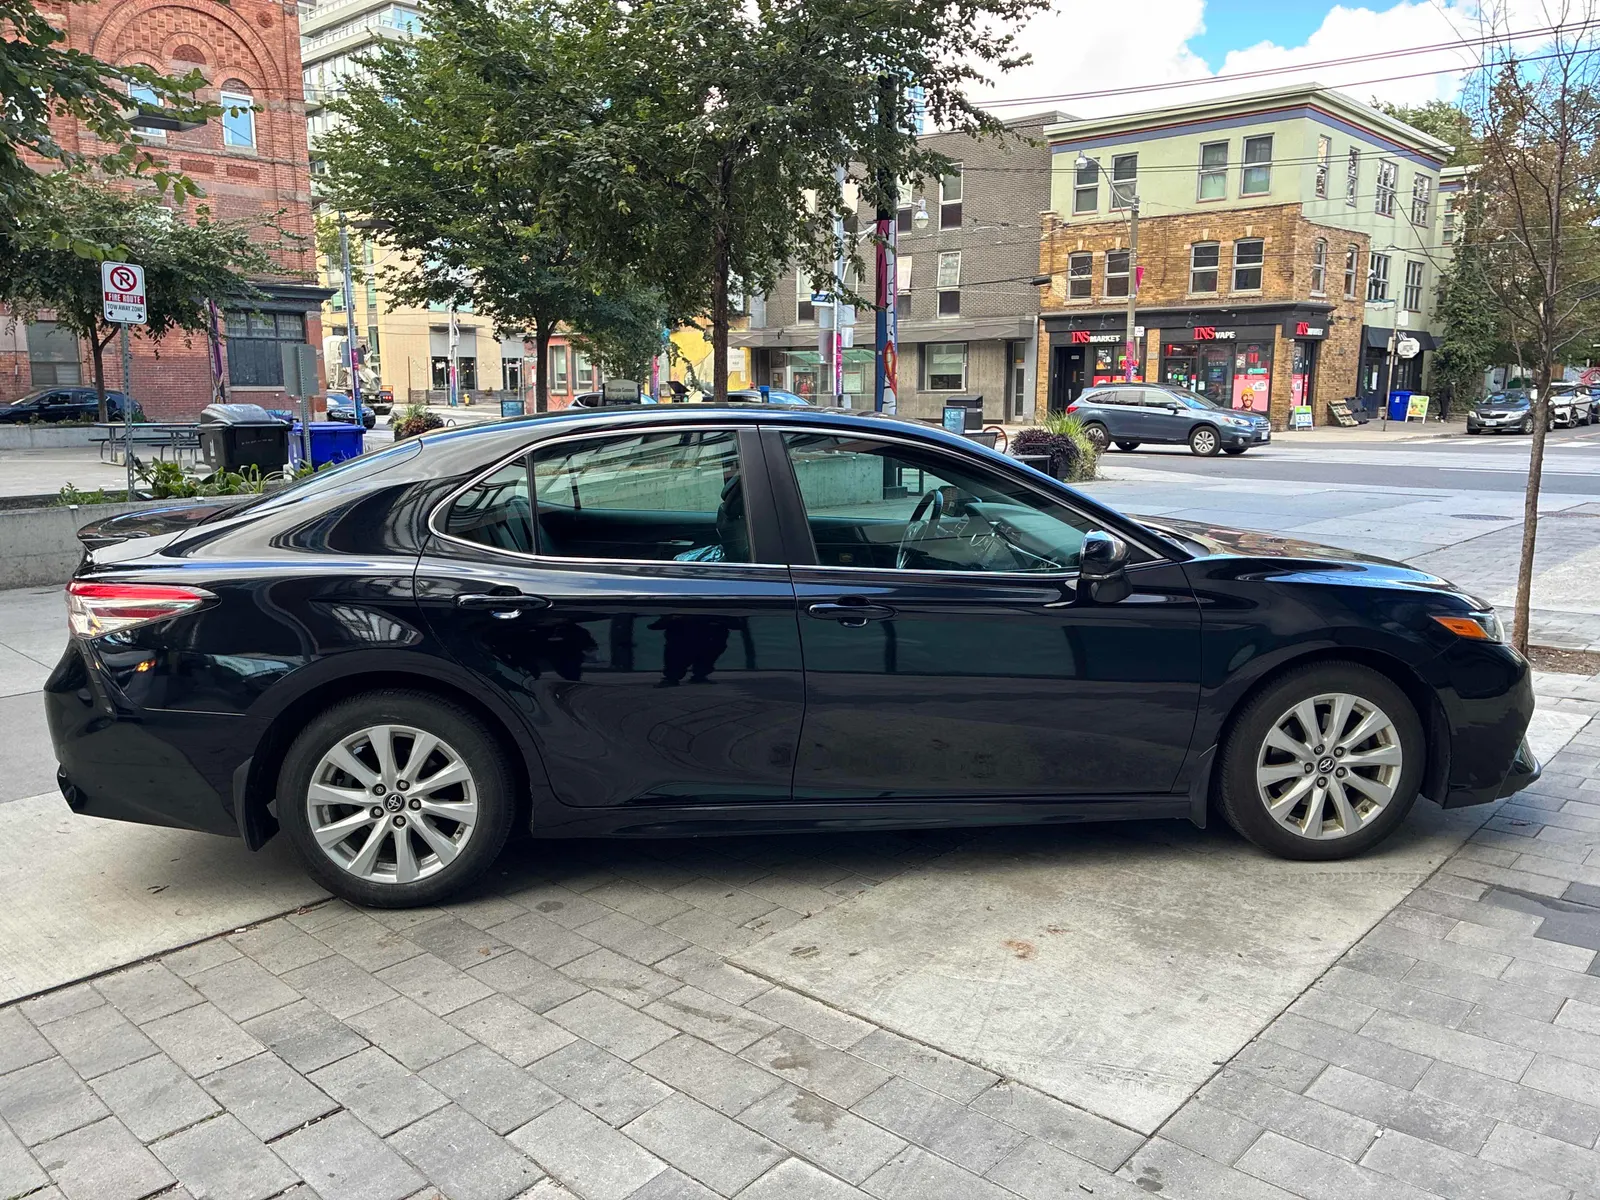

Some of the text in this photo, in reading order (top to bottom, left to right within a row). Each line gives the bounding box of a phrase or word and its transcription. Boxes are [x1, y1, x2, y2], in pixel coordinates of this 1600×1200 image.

[108, 293, 141, 303] FIRE ROUTE
[1071, 331, 1121, 343] INS MARKET
[1194, 327, 1236, 340] INS VAPE
